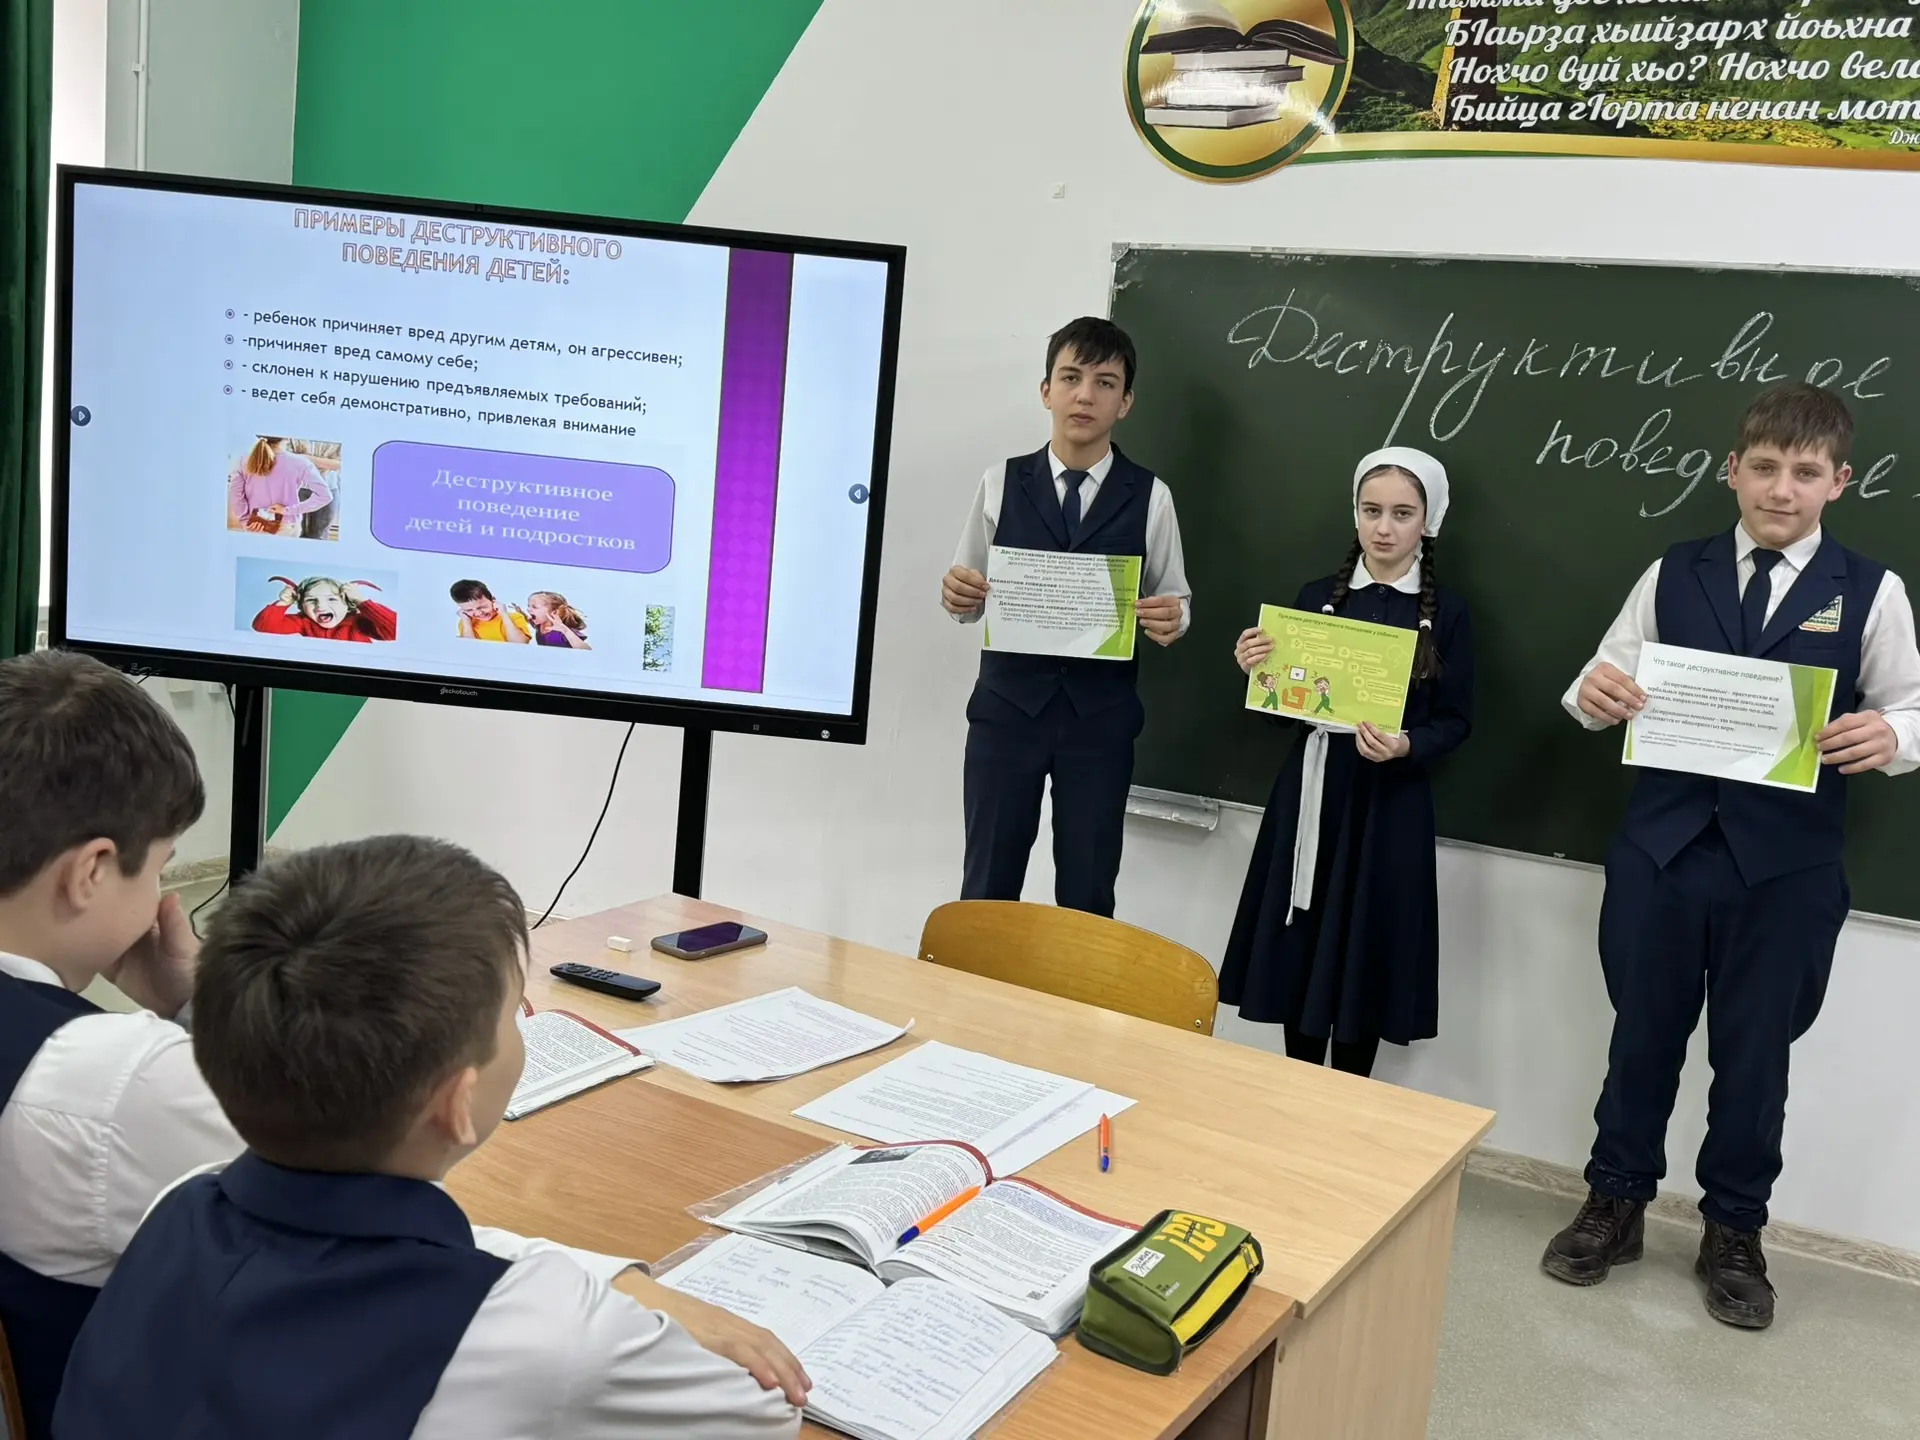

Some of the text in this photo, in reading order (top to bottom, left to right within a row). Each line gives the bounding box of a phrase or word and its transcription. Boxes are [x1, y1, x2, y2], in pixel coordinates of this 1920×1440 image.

[1775, 12, 1915, 40] йоьхна
[1449, 56, 1549, 84] Нохчо
[1558, 55, 1622, 90] вуй
[1625, 55, 1707, 83] хьо?
[1717, 52, 1830, 81] Нохчо
[1451, 94, 1561, 129] Бийца
[1706, 99, 1818, 121] ненан
[294, 208, 622, 260] ПРИМЕРЫ ДЕСТРУКТИВНОГО
[342, 243, 570, 285] ПОВЕДЕНИЯ ДЕТЕЙ:
[243, 336, 478, 372] -причиняет вред самому себе;
[253, 310, 316, 327] ребенок
[322, 318, 402, 335] причиняет
[408, 327, 445, 342] вред
[450, 332, 505, 347] другим
[510, 337, 561, 355] детям,
[568, 343, 586, 355] он
[591, 346, 683, 368] агрессивен;
[252, 362, 314, 378] склонен
[320, 369, 328, 379] к
[334, 370, 419, 388] нарушению
[426, 379, 548, 402] предъявляемых
[554, 393, 647, 415] требований;
[252, 387, 295, 402] ведет
[301, 391, 335, 405] себя
[340, 397, 471, 422] демонстративно,
[478, 410, 556, 428] привлекая
[563, 419, 636, 437] внимание
[432, 469, 613, 502] Деструктивное
[457, 498, 580, 522] поведение
[405, 516, 636, 550] детей и подростков
[1653, 656, 1783, 682] Что такое деструктивное поведение?
